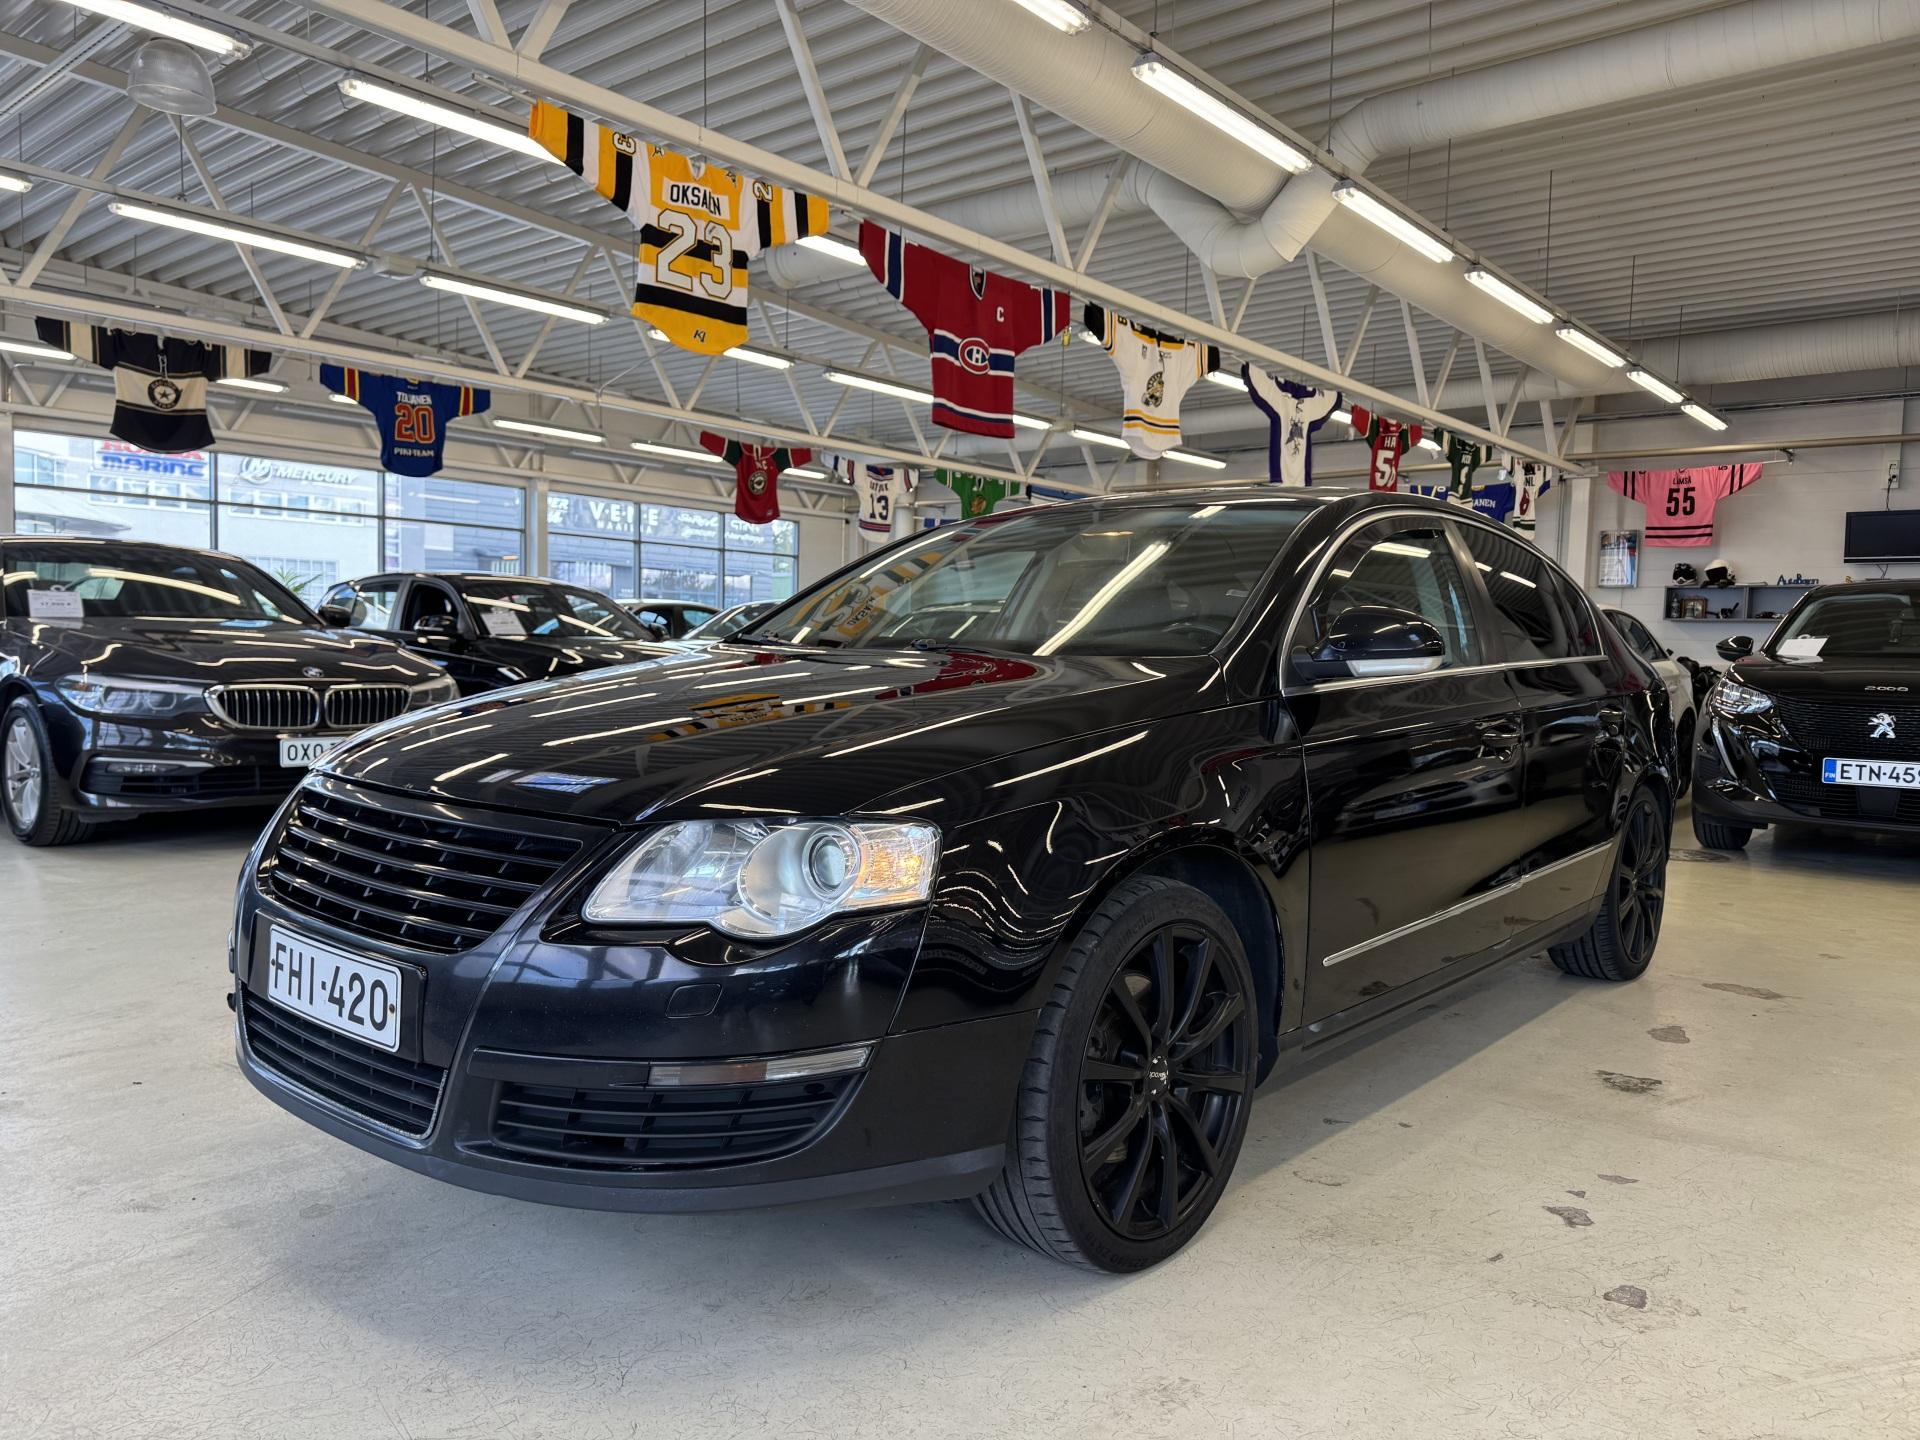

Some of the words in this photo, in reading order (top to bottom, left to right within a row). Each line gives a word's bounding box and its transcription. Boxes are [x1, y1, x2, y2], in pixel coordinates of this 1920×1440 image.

[656, 208, 733, 300] 23
[996, 306, 1005, 322] C
[395, 403, 435, 444] 20
[275, 466, 358, 485] MERCURY
[869, 494, 889, 521] 13
[1472, 498, 1496, 509] ANEN
[1666, 487, 1696, 517] 55
[1840, 763, 1920, 786] ETN-45
[274, 942, 389, 1032] FHI-420
